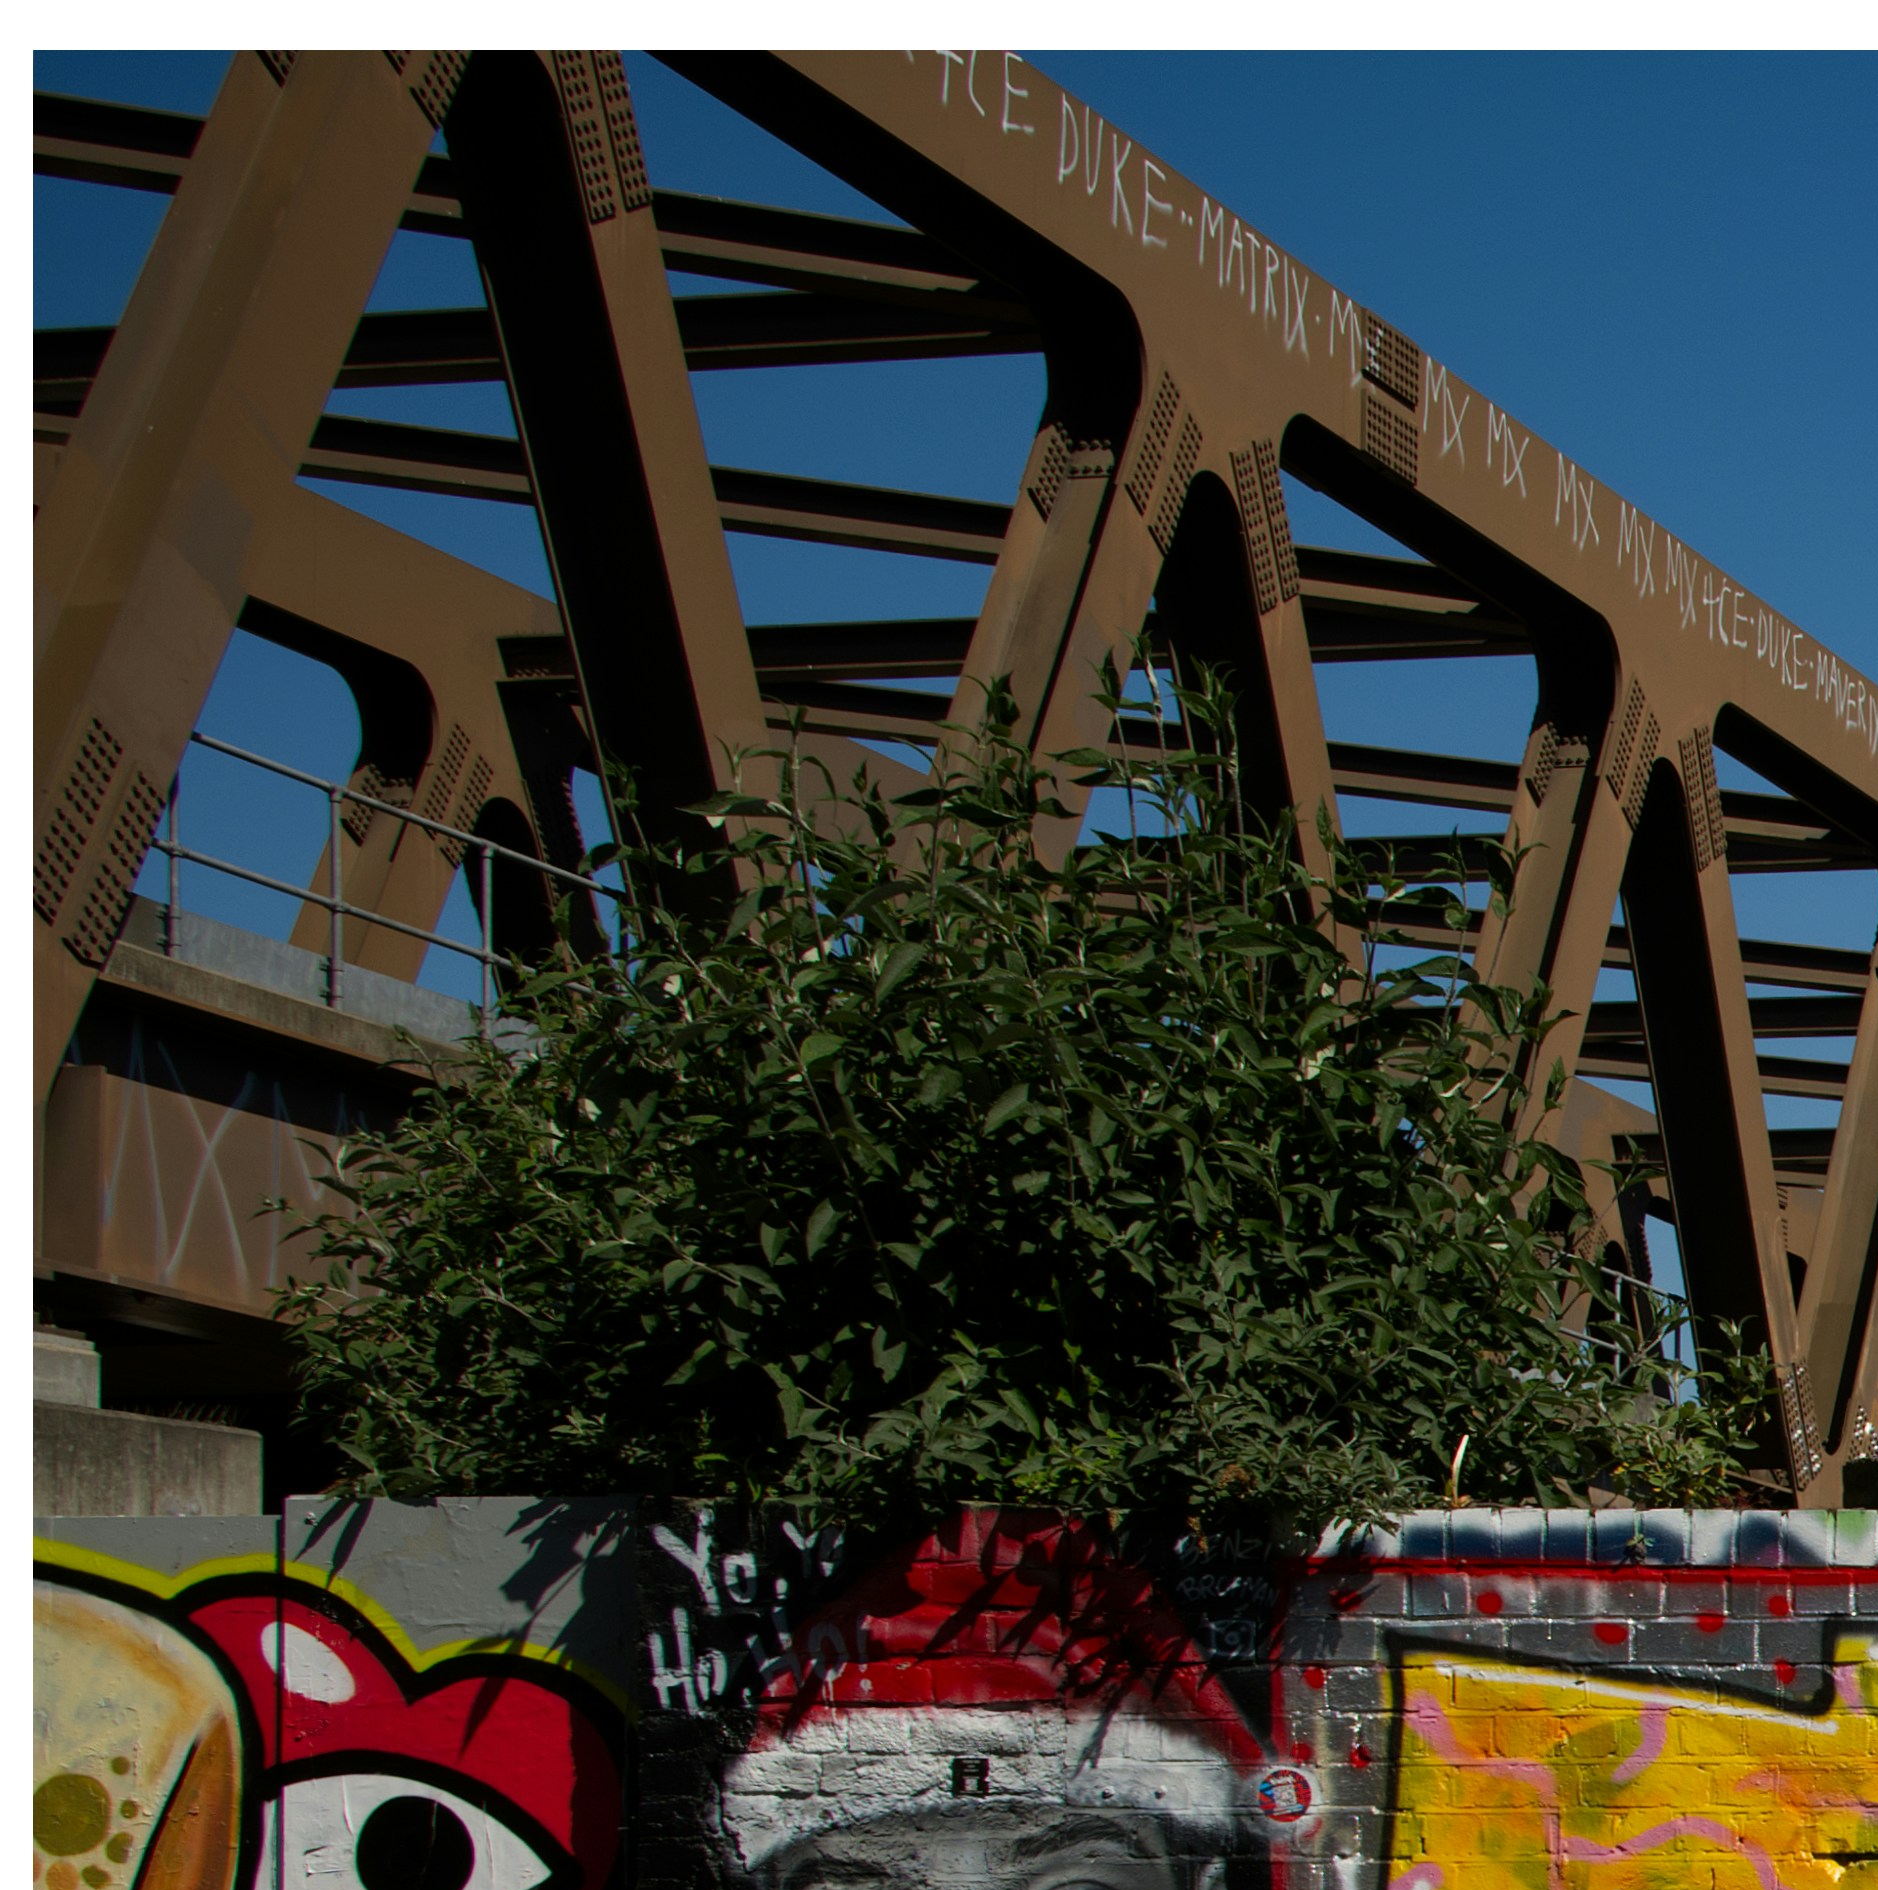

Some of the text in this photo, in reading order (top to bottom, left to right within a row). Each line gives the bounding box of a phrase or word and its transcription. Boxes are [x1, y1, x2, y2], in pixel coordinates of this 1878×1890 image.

[1058, 93, 1173, 247] DUKE
[1198, 196, 1310, 364] MATRIX
[1423, 355, 1470, 467] MX
[1486, 402, 1530, 498] MX
[1555, 451, 1600, 551] MX
[1617, 500, 1655, 599] MX
[1664, 533, 1698, 630] MX
[1757, 608, 1808, 690] DUKE
